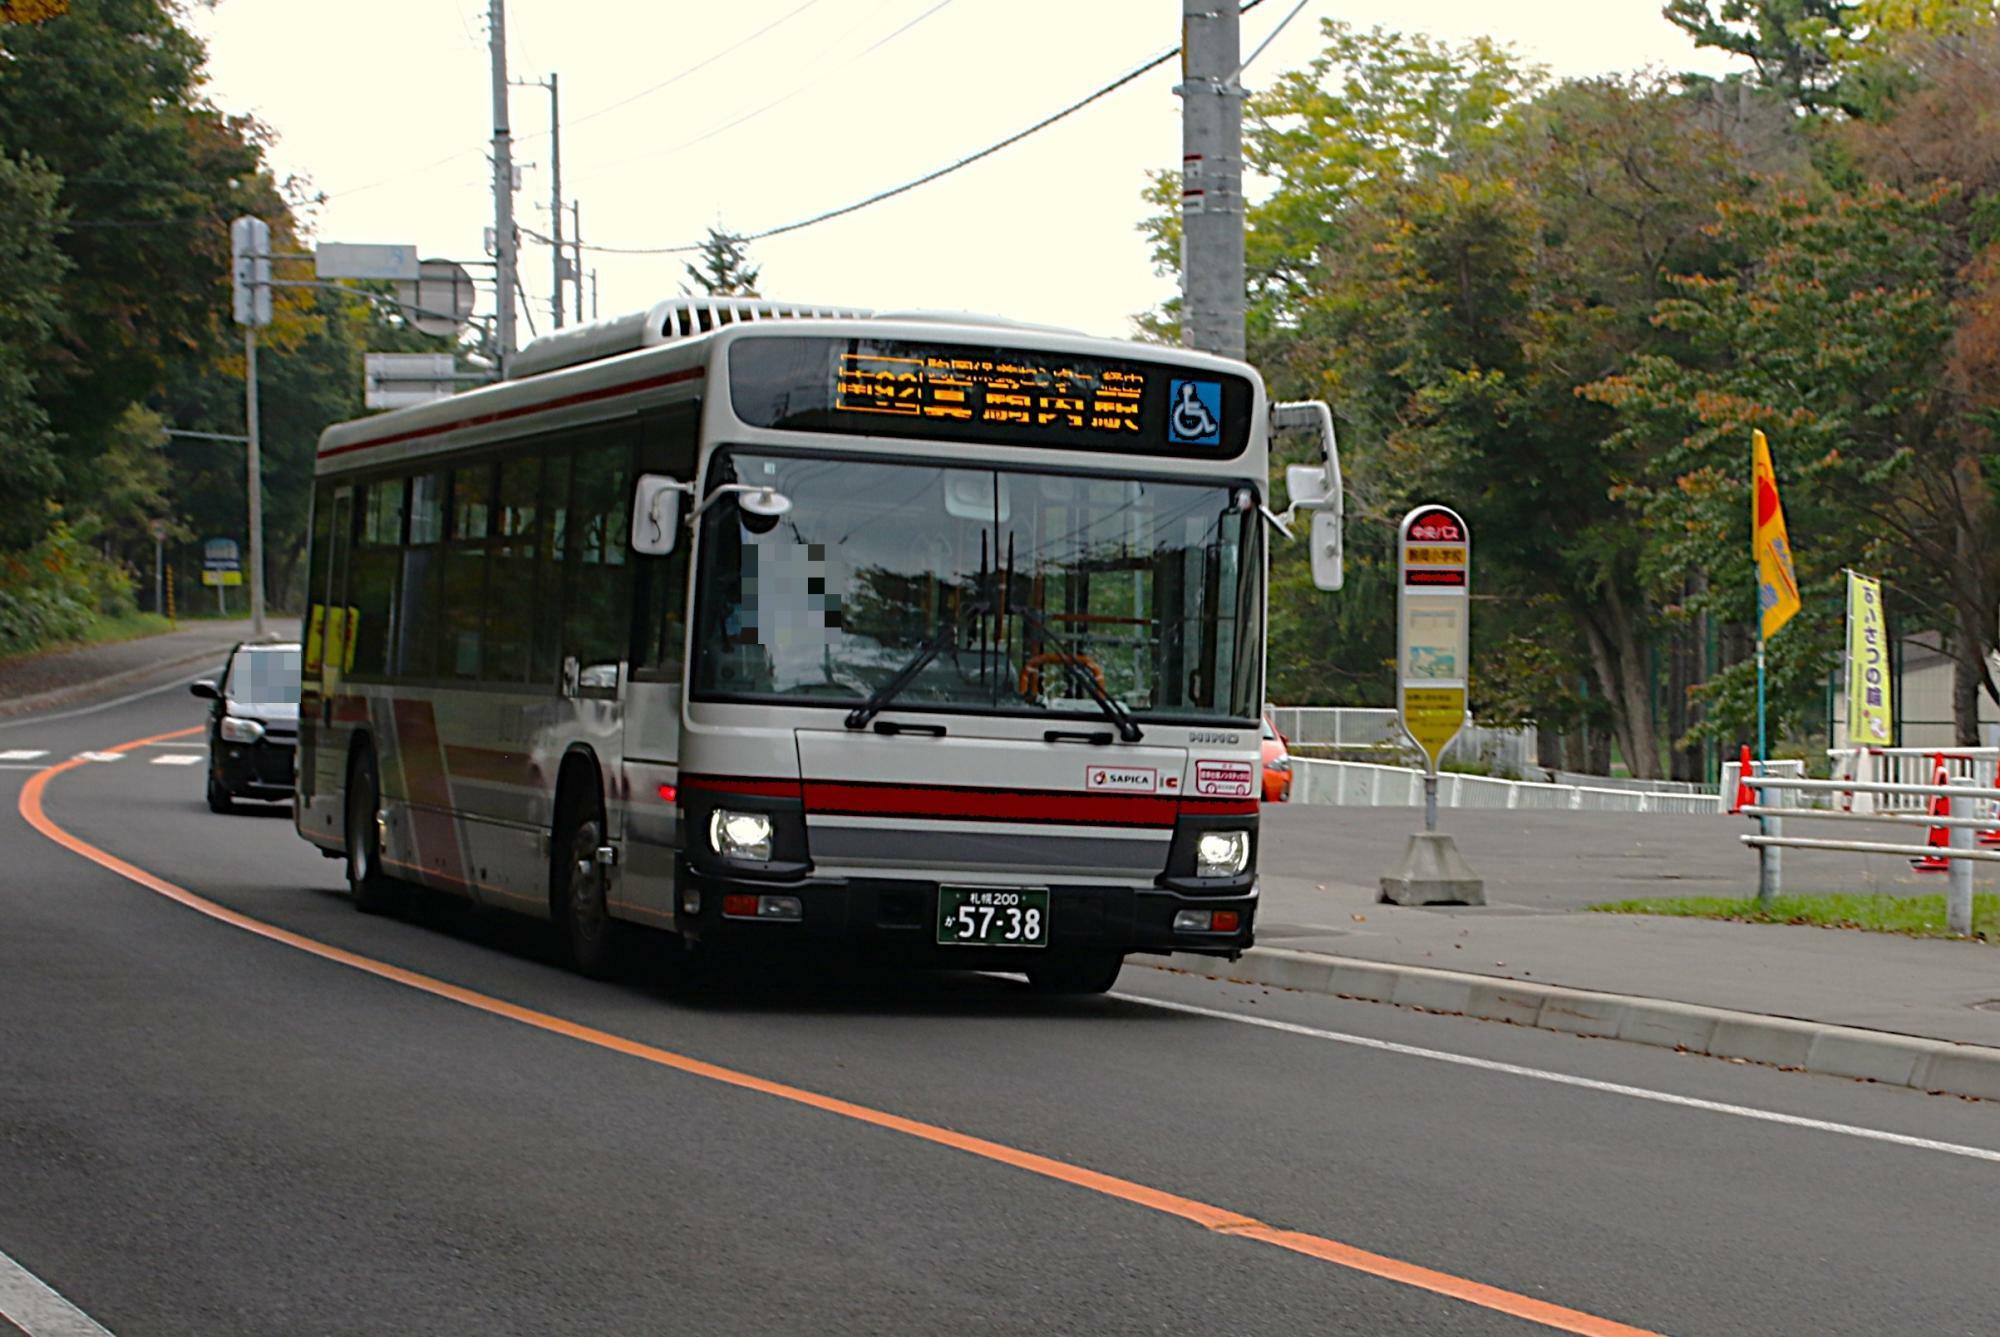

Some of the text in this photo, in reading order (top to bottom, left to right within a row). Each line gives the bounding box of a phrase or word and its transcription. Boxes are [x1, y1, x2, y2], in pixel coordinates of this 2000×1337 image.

[1189, 732, 1239, 744] HINO
[1109, 775, 1149, 786] SAPICA
[958, 906, 1040, 940] 57-38
